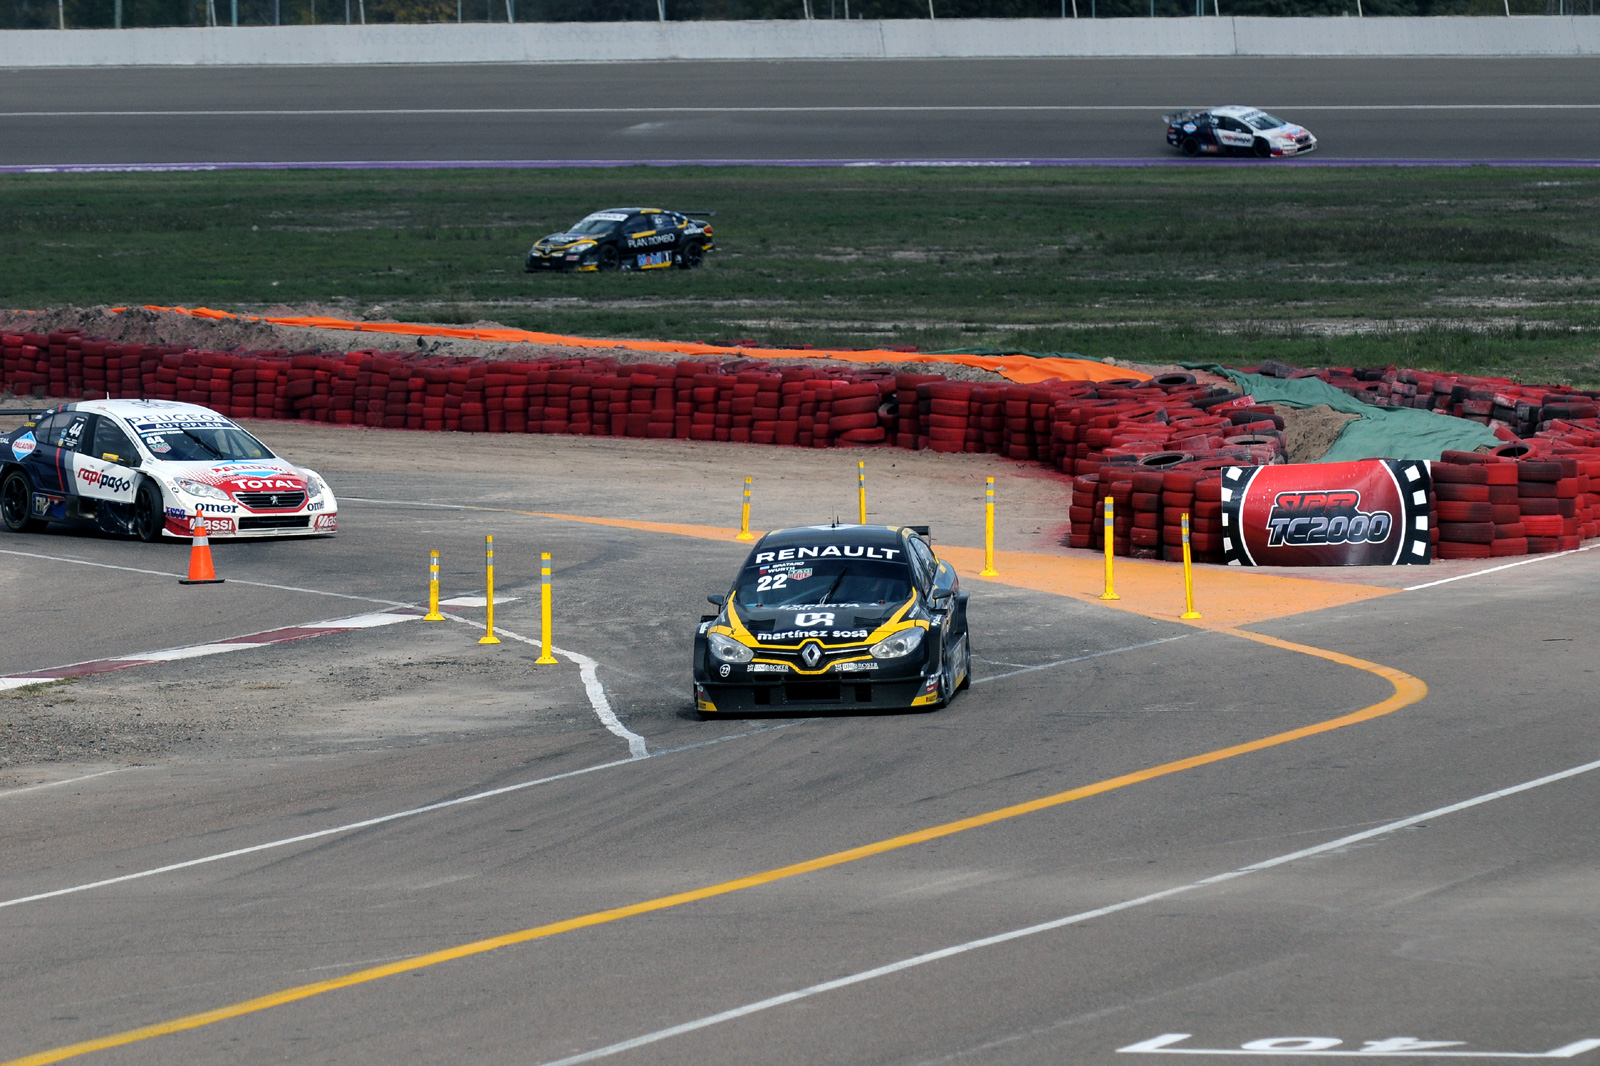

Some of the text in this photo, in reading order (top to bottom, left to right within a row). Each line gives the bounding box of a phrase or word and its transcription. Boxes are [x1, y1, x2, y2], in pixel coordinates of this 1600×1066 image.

[628, 238, 649, 249] PLAN
[127, 414, 226, 425] PEUGEOT
[155, 422, 223, 430] AUTOPLAN
[69, 422, 84, 437] 44
[146, 436, 165, 445] 44
[78, 467, 131, 493] rapipago
[231, 479, 302, 490] TOTAL
[195, 503, 239, 514] omer
[1274, 492, 1358, 515] SUPER
[1269, 514, 1391, 546] TC2000
[755, 545, 900, 564] RENAULT
[756, 574, 788, 592] 22
[757, 629, 828, 641] martínez
[1241, 1036, 1469, 1052] 40
